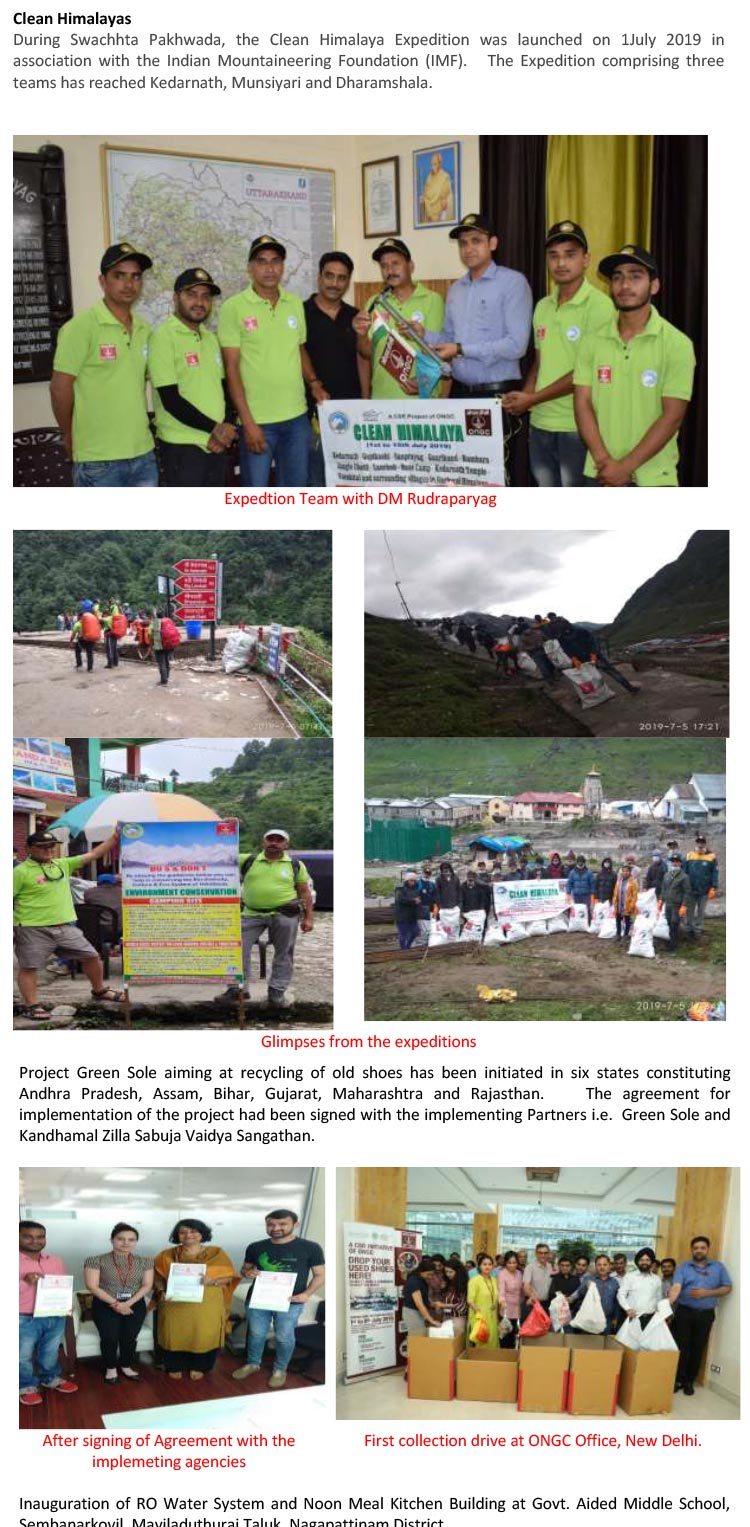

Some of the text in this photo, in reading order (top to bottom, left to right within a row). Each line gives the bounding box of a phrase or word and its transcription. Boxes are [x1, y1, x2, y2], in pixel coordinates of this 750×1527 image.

[13, 12, 131, 27] Clean Himalayas
[13, 76, 432, 91] teams has reached Kedarnath, Munsiyari and Dharamshala.
[246, 188, 307, 200] UTTARAKHAND
[354, 424, 464, 442] CLEAN HIMALAYA
[225, 492, 497, 507] Expedtion Team with DM Rudraparyag
[180, 888, 237, 896] CONSERVATION
[261, 1035, 476, 1050] Glimpses from the expeditions
[348, 1256, 391, 1266] DROP YOUR
[348, 1264, 369, 1272] USED
[365, 1434, 701, 1449] First collection drive at ONGC Office, New Delhi.
